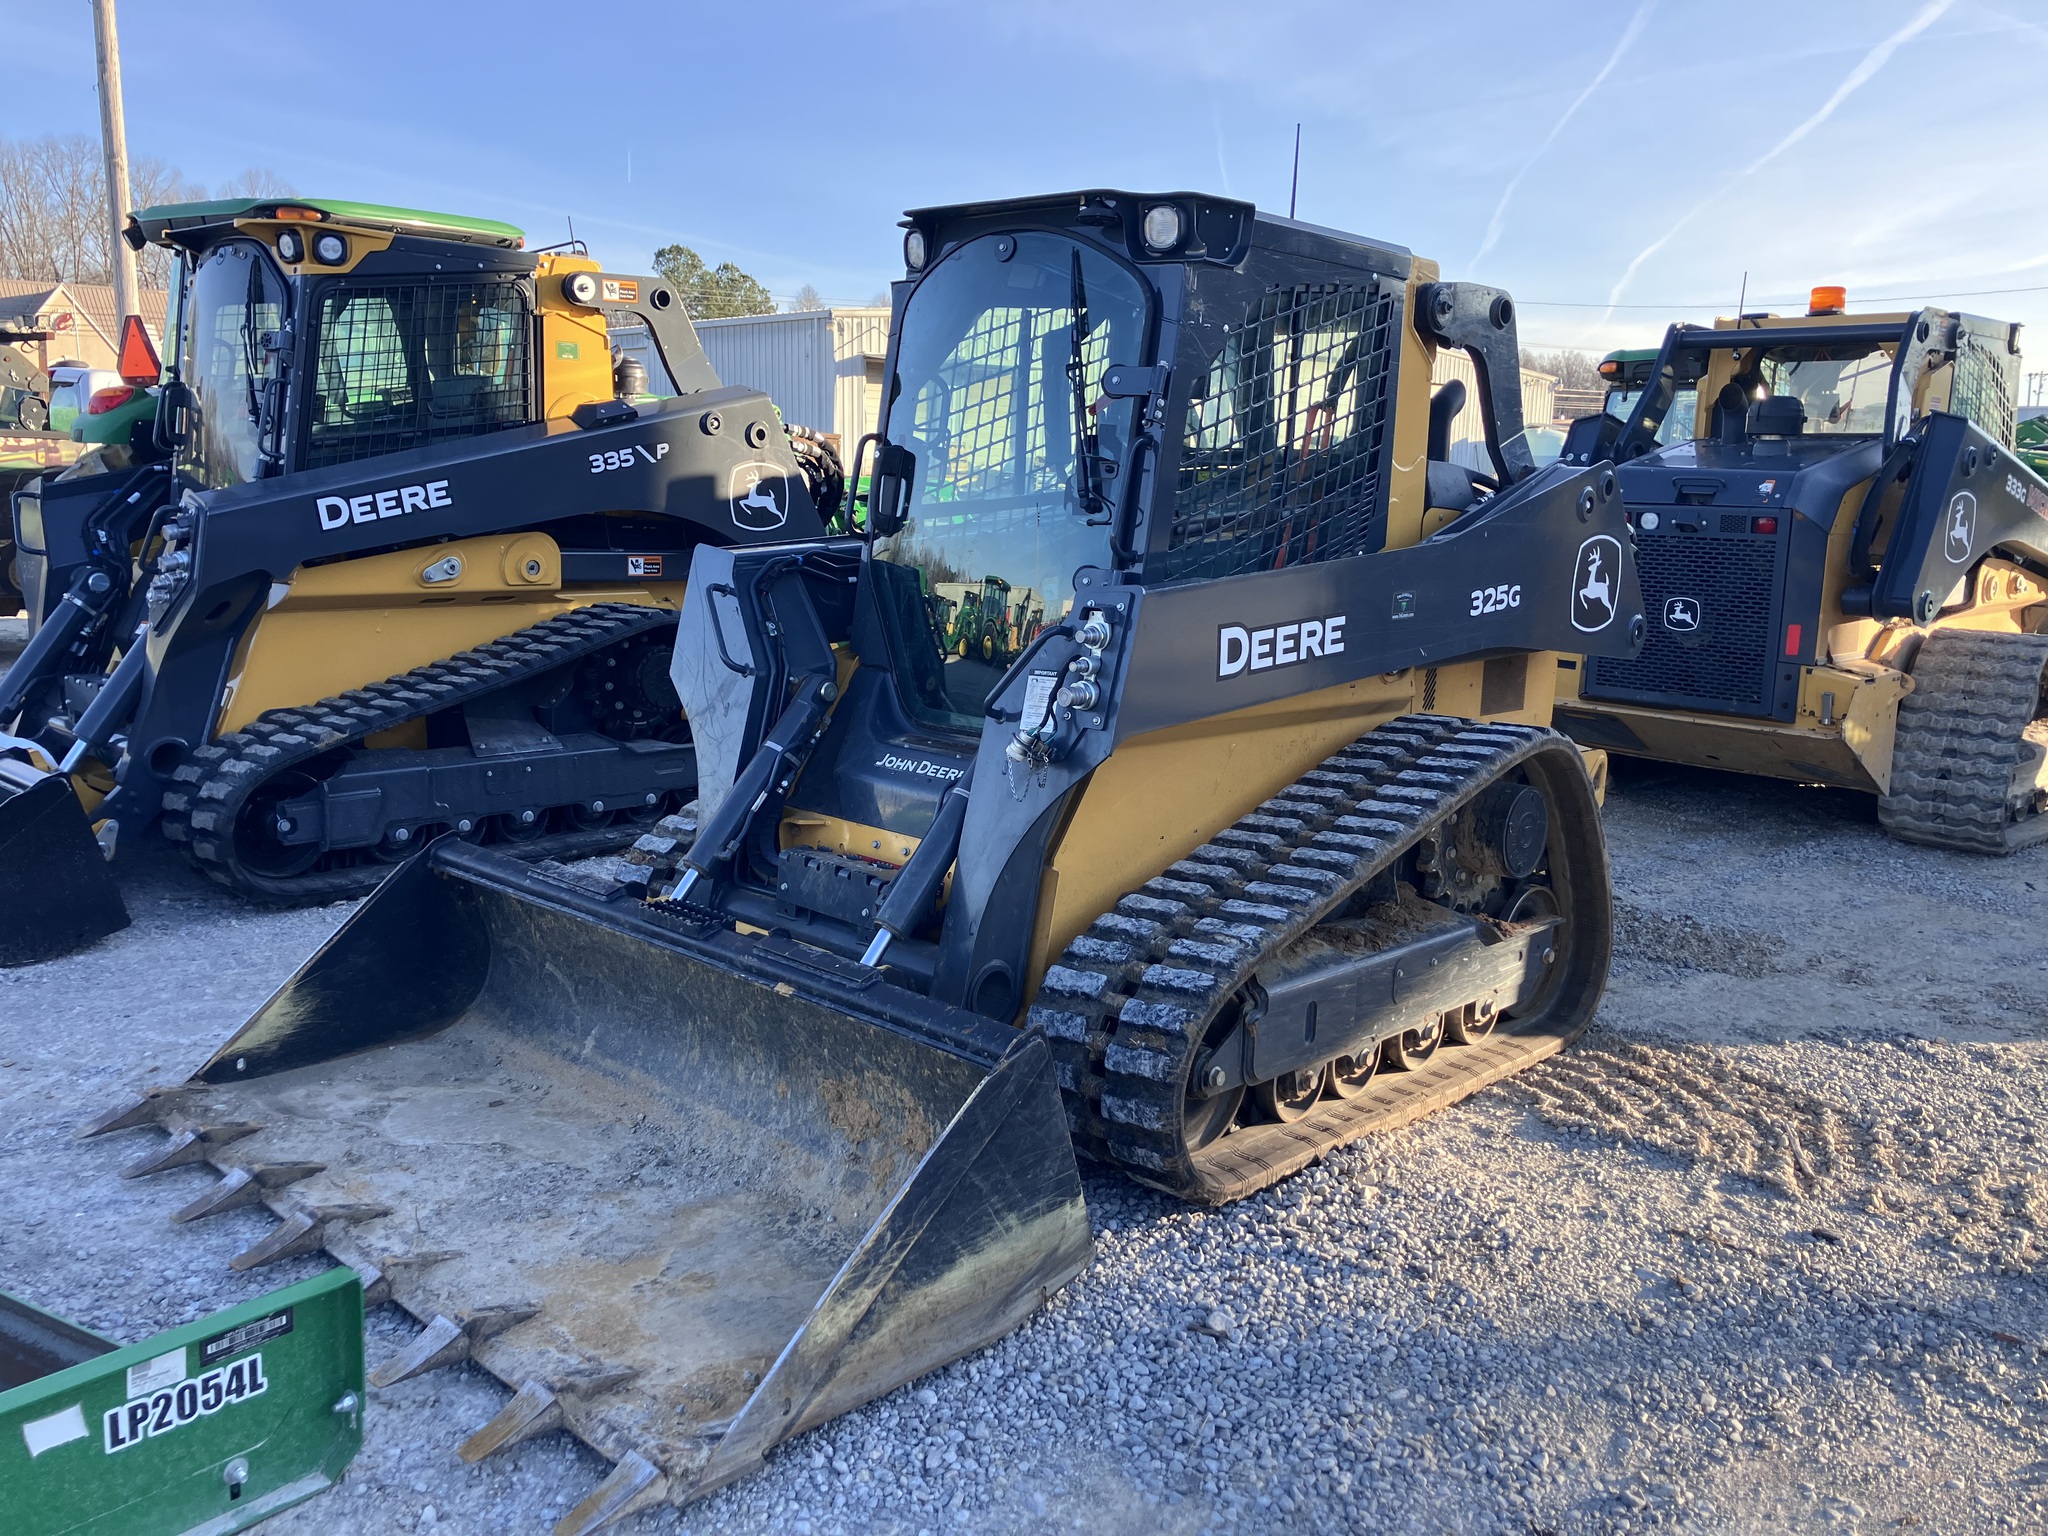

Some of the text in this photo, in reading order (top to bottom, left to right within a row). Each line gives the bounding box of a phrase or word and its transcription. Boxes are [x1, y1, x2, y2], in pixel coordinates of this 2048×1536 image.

[316, 479, 453, 532] DEERE
[2005, 474, 2027, 504] 333G
[1470, 584, 1521, 617] 325G
[1219, 615, 1346, 677] DEERE
[875, 753, 918, 772] JOHN
[107, 1355, 266, 1452] LP2054L
